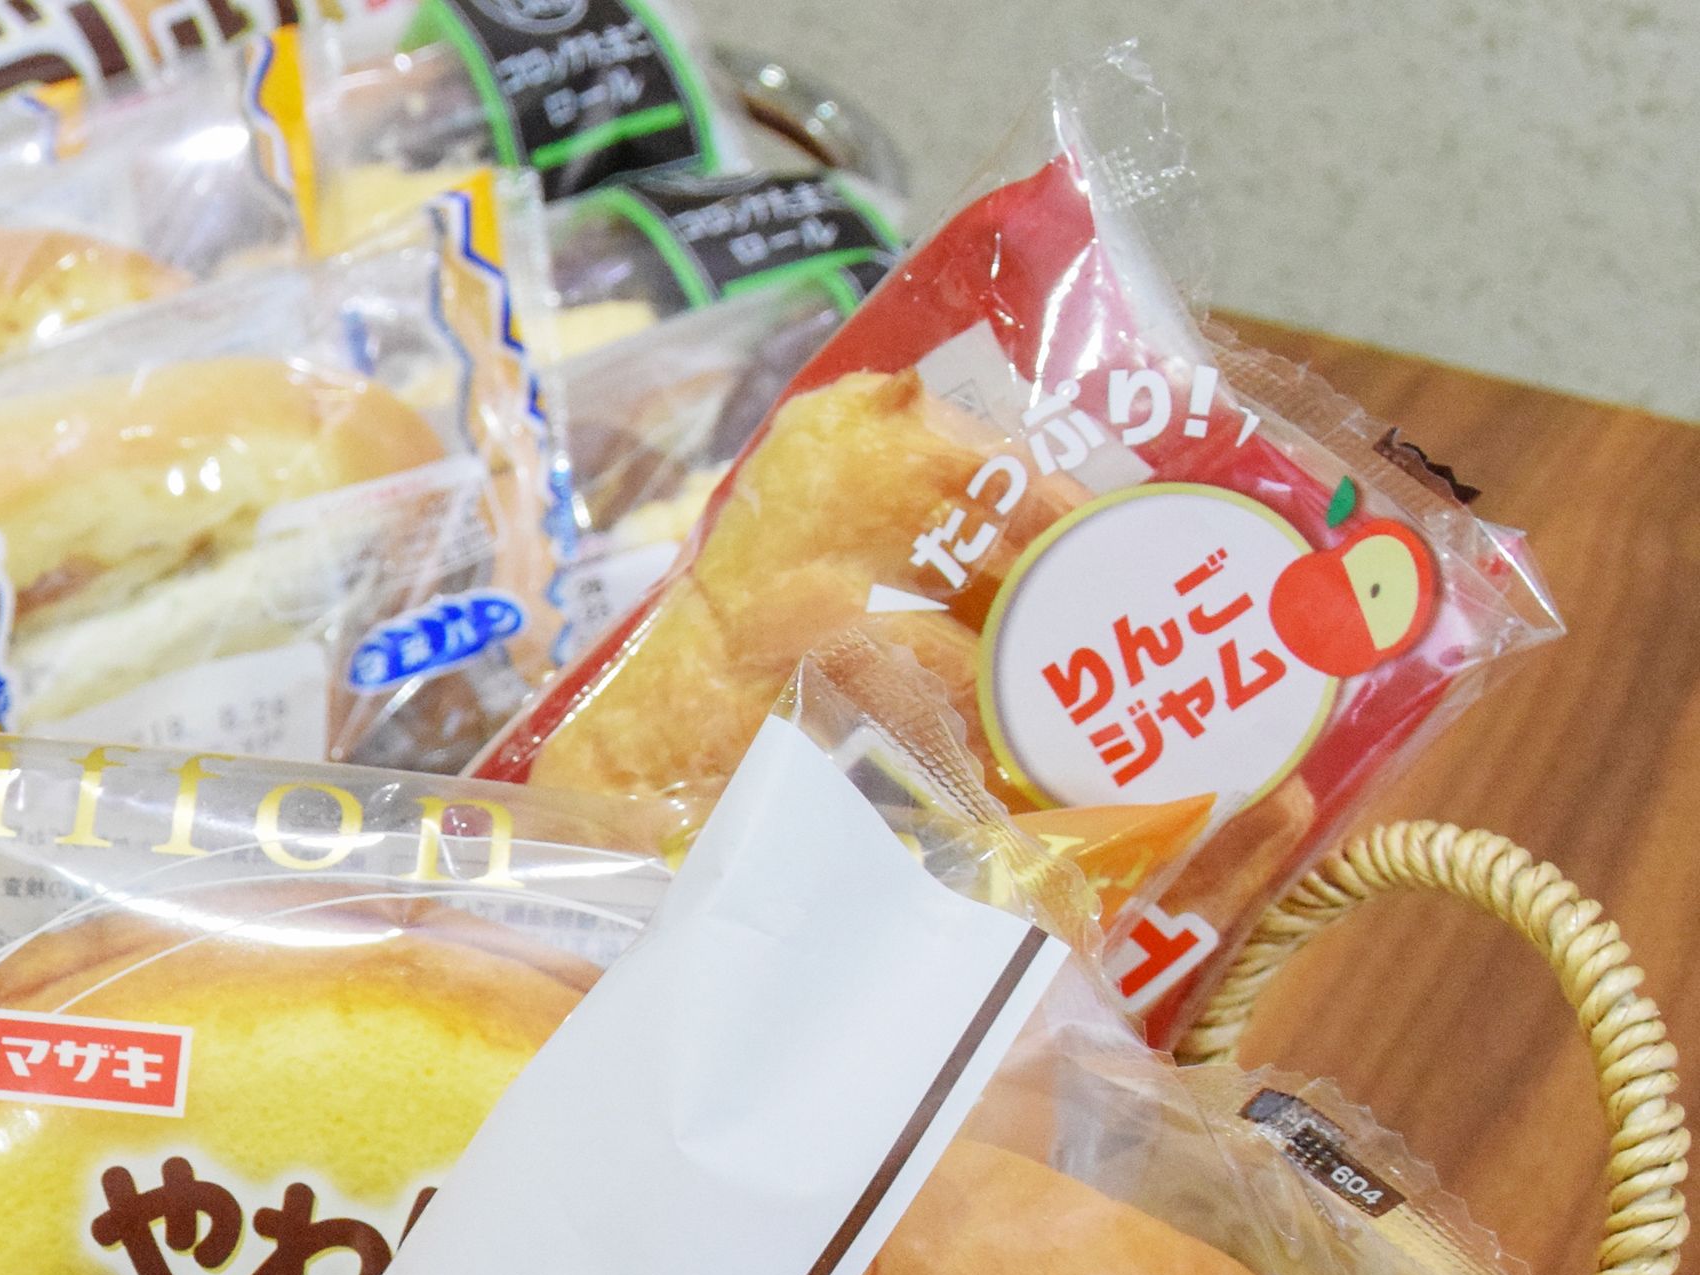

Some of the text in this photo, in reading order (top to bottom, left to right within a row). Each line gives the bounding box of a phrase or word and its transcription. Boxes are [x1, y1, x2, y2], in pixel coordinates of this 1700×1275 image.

[1039, 546, 1256, 726] りんご
[1086, 637, 1289, 789] ジャム
[1330, 1165, 1384, 1205] 604
